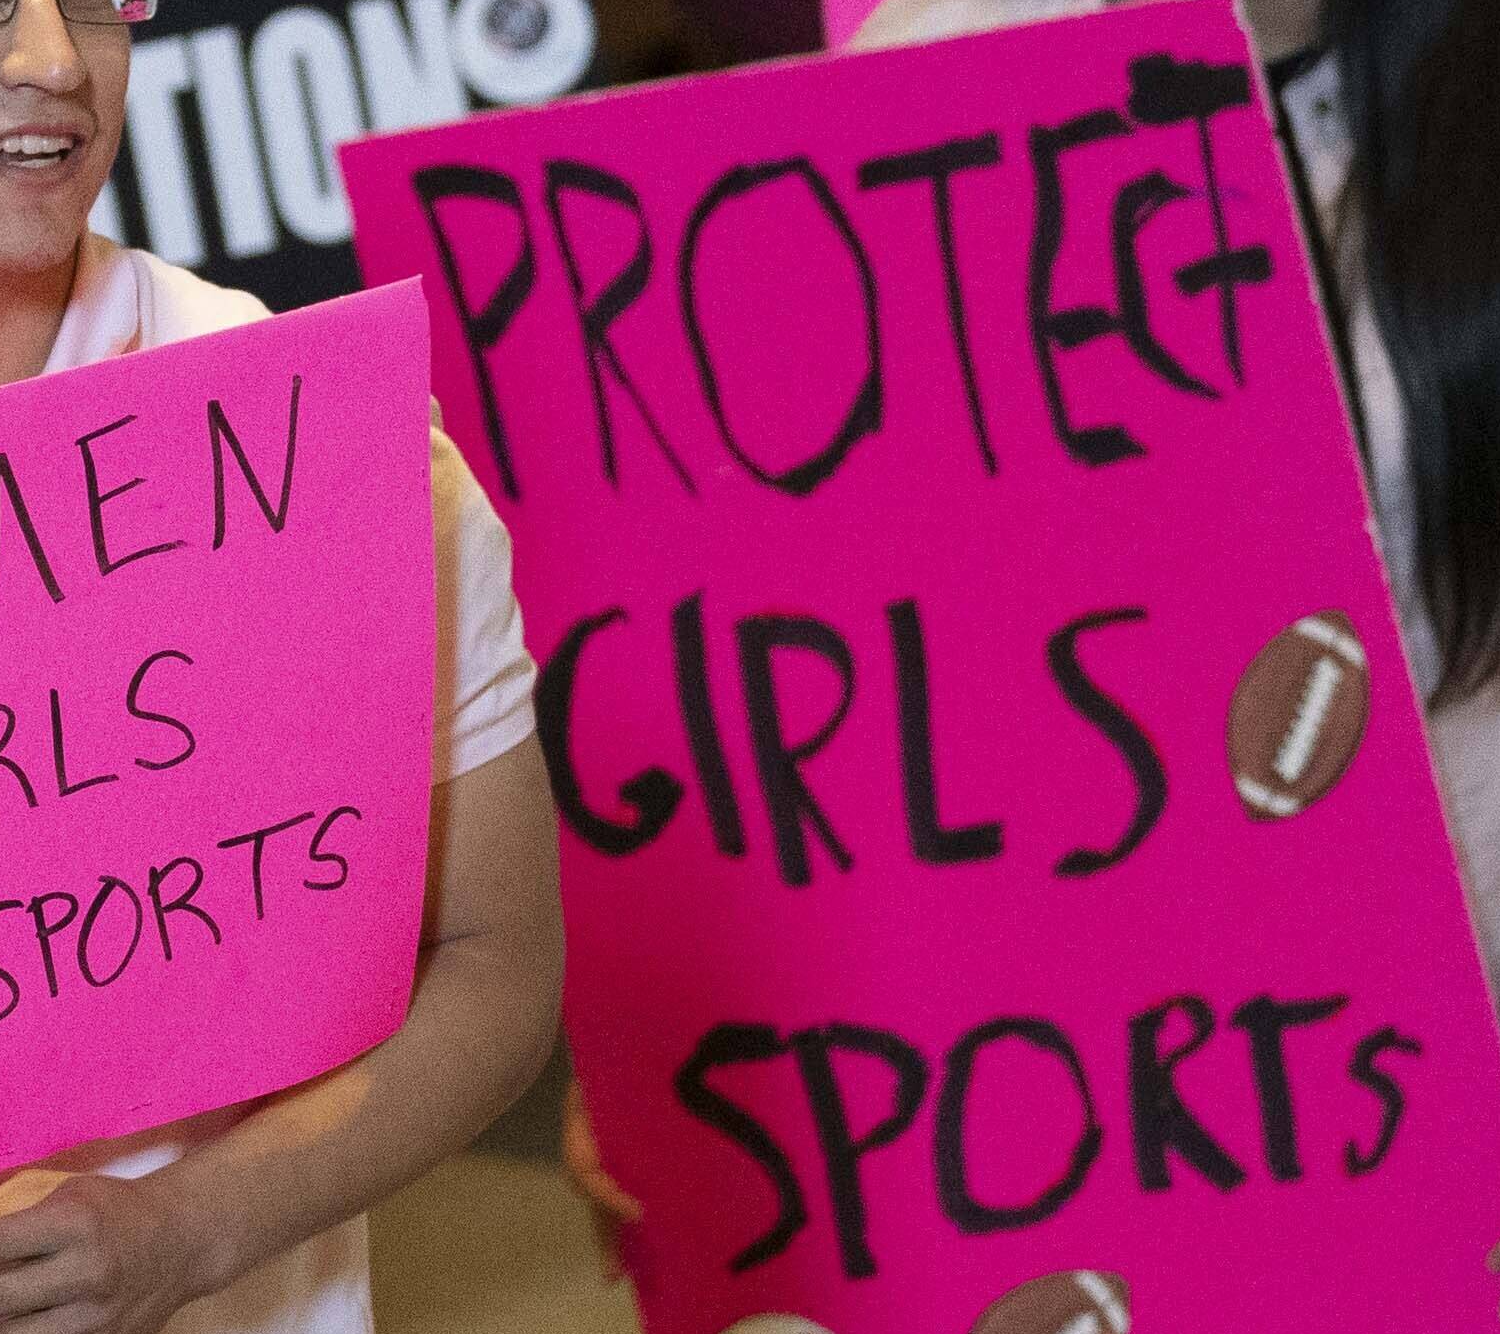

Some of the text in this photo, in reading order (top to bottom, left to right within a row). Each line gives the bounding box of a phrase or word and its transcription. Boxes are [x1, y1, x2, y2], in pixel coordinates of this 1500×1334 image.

[412, 53, 1275, 503] PROTECT
[532, 589, 1168, 889] GIRLS
[673, 993, 1424, 1279] SPORTS
